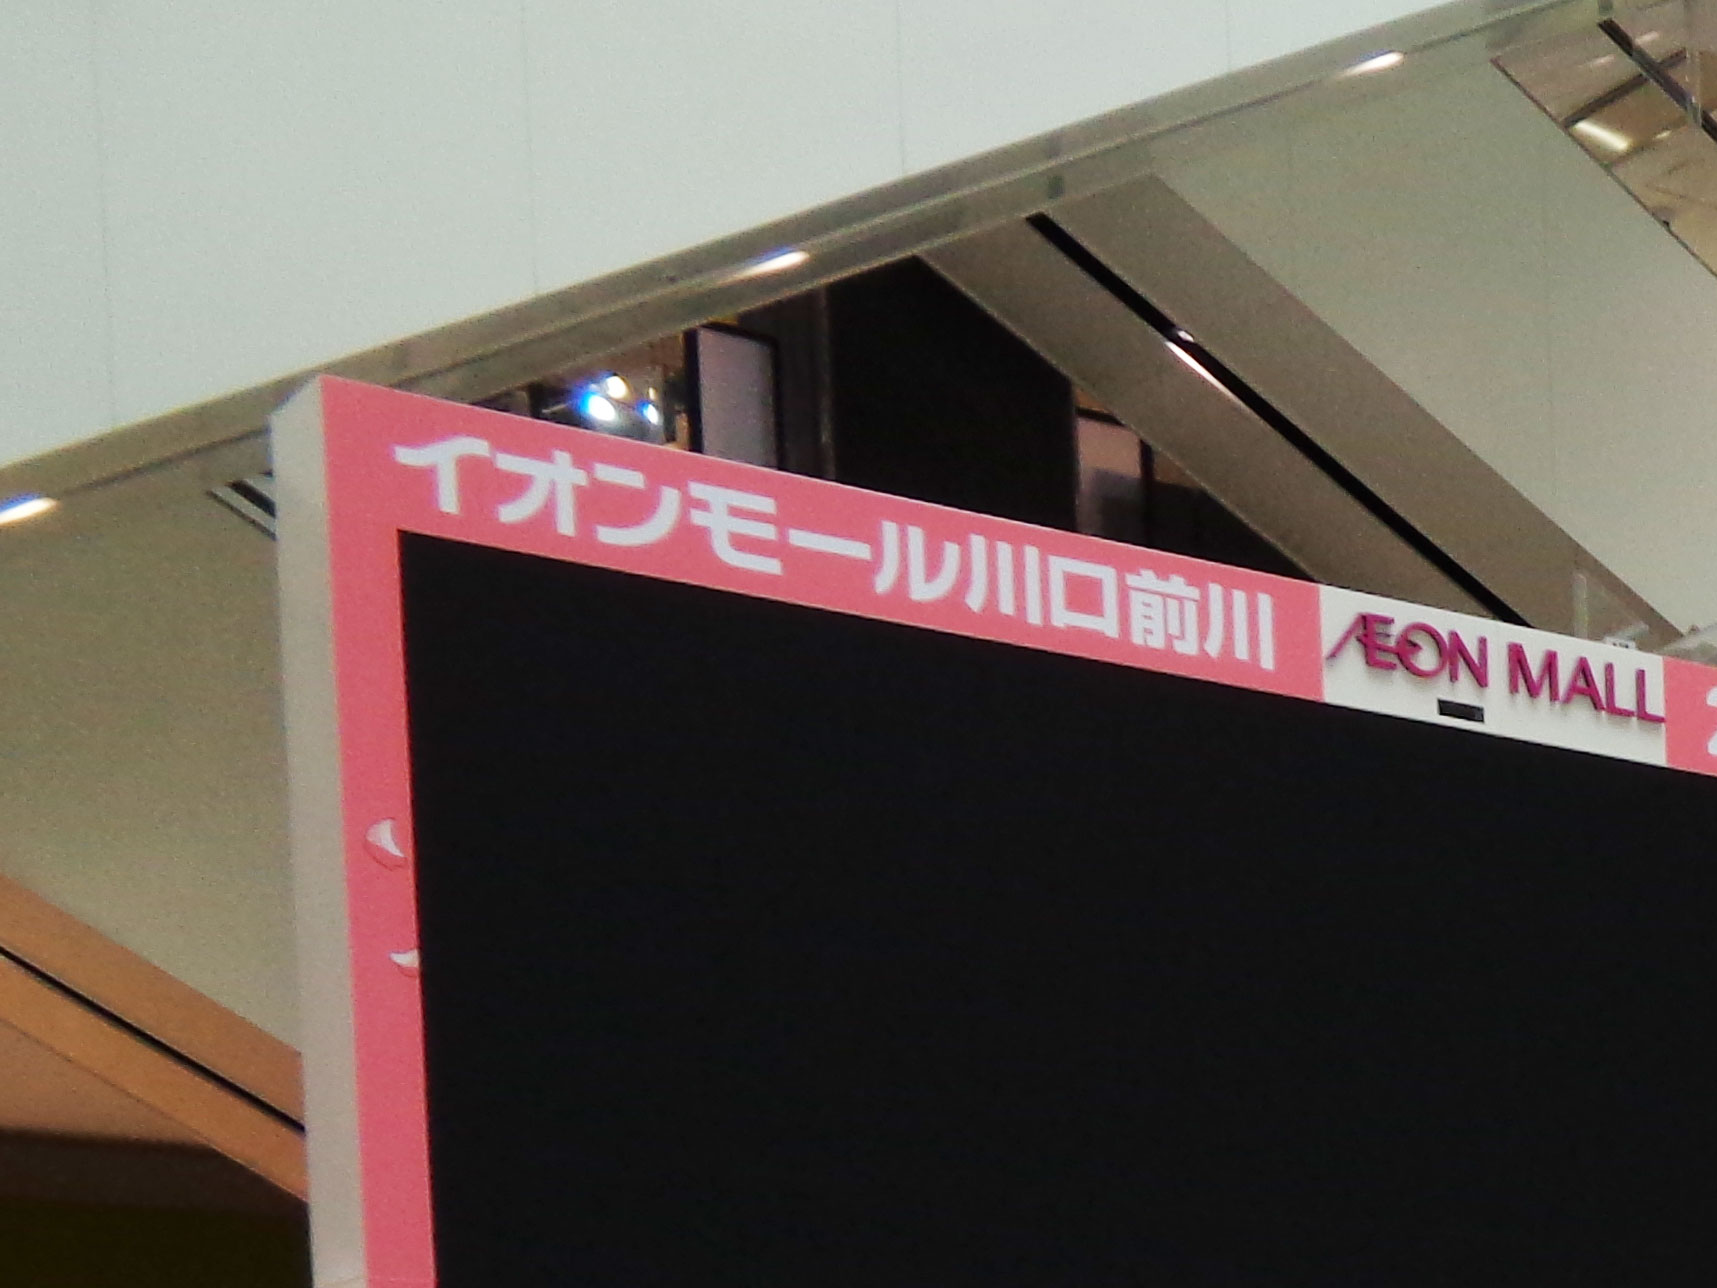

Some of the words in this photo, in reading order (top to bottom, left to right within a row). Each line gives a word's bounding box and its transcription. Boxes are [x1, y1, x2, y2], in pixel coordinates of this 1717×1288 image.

[394, 436, 1276, 671] イオンモール川口前川
[1508, 641, 1665, 723] MALL
